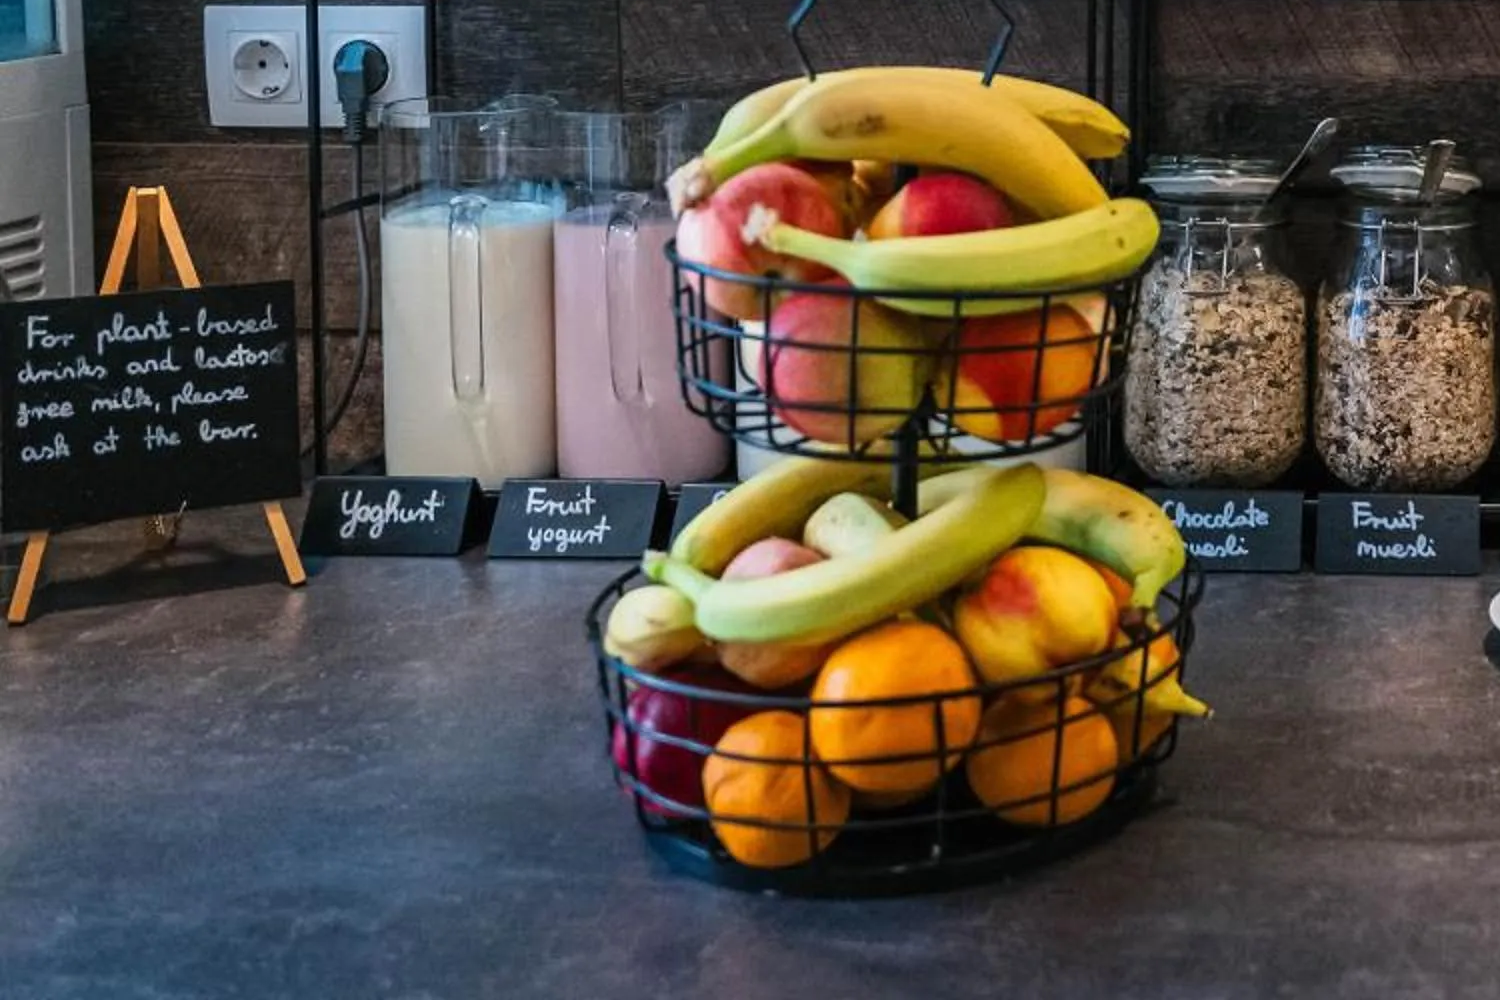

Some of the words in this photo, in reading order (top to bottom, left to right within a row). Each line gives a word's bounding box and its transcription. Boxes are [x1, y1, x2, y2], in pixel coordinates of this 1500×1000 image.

[26, 315, 75, 349] For
[17, 355, 108, 384] drinks
[126, 346, 181, 376] and
[195, 342, 287, 369] lactose
[16, 401, 75, 428] free
[91, 385, 160, 413] milk,
[171, 380, 249, 414] please
[20, 433, 70, 462] ask
[93, 426, 120, 455] at
[143, 424, 181, 450] the
[200, 419, 258, 442] bar.
[340, 489, 441, 538] Yoghurt
[525, 487, 597, 515] Fruit
[1351, 499, 1424, 531] Fruit
[528, 515, 611, 551] yogurt
[1184, 534, 1249, 558] uesli
[1357, 533, 1437, 559] muesli
